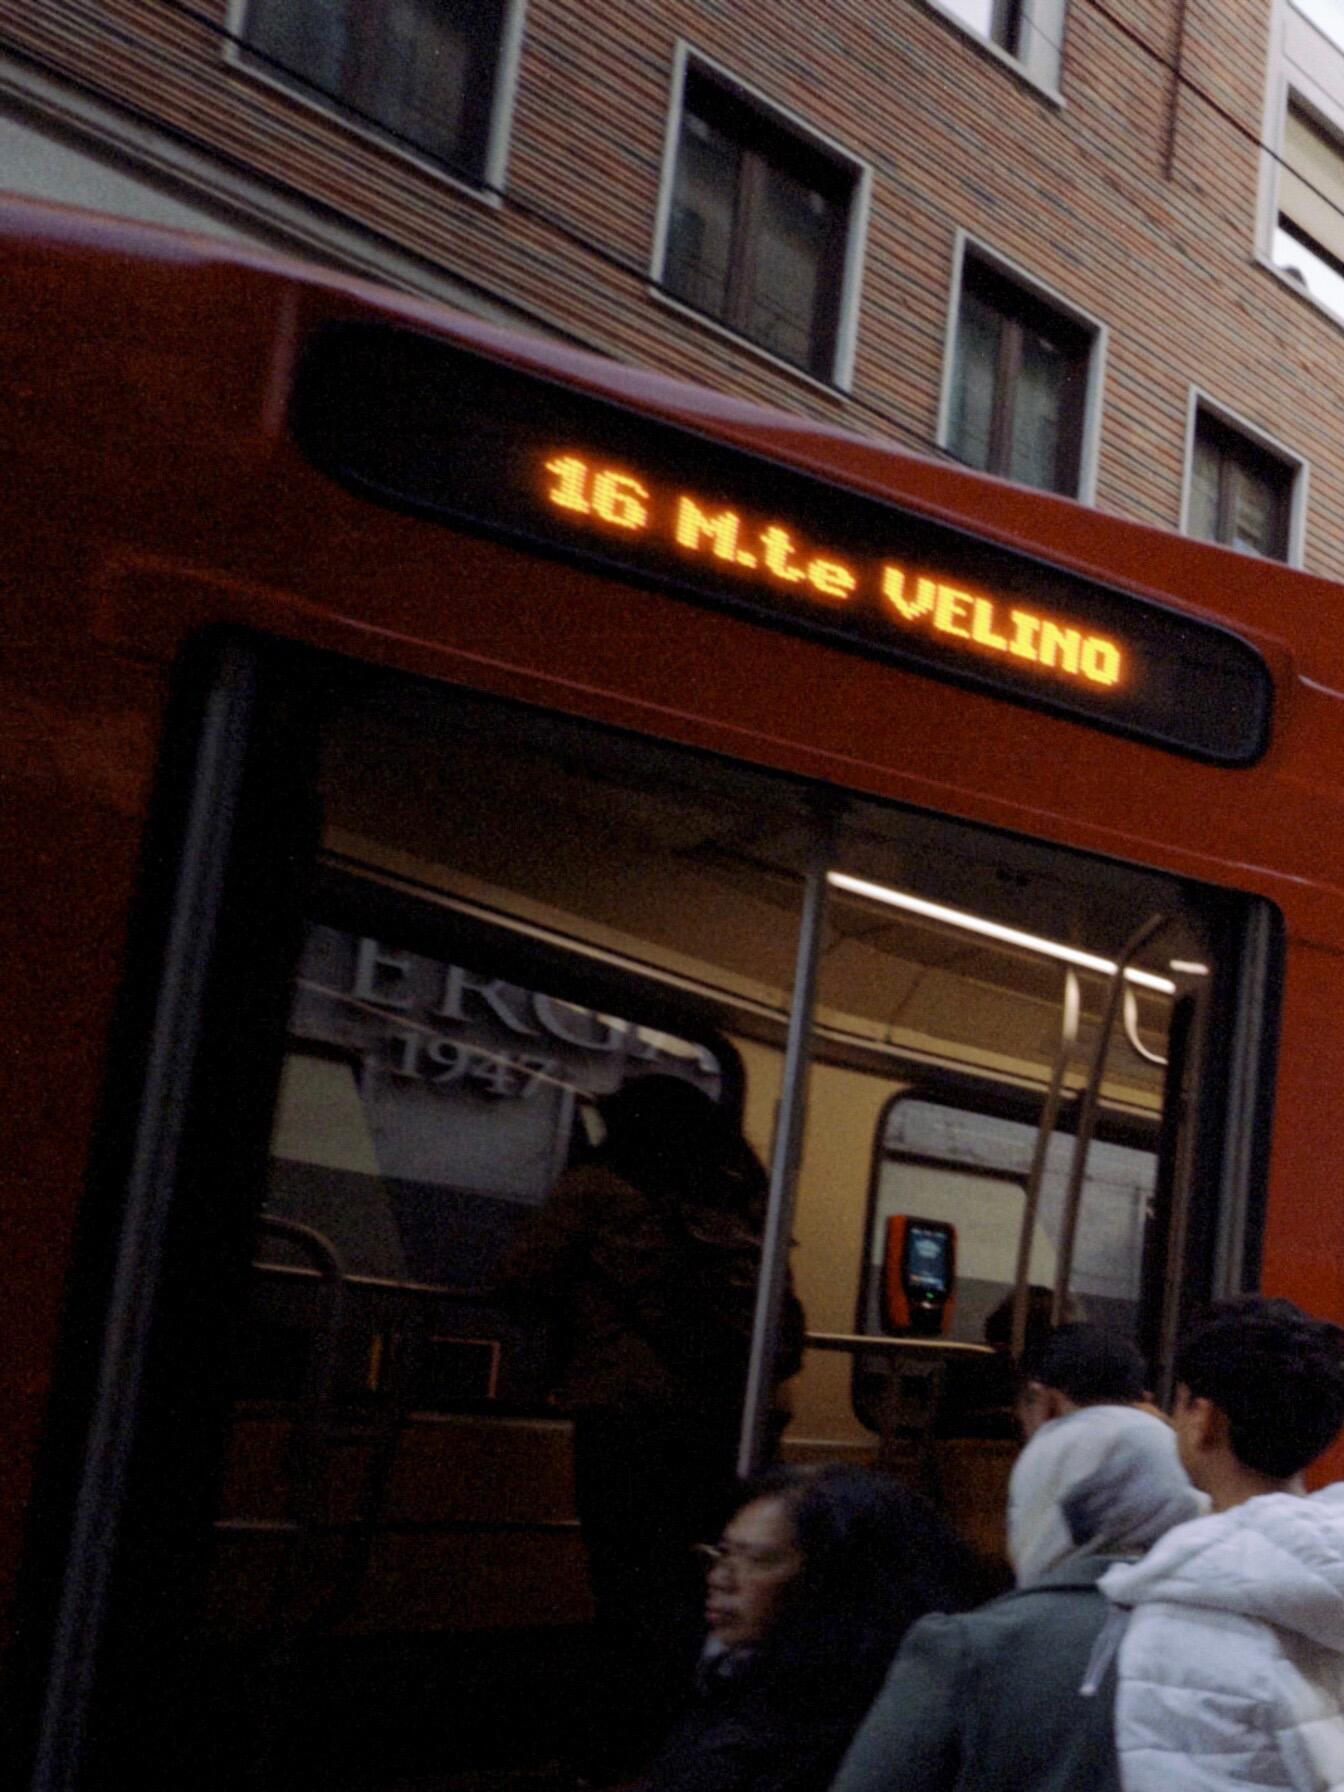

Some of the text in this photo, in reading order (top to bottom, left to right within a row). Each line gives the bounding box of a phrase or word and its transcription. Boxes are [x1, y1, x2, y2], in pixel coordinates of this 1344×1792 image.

[546, 453, 1122, 686] 16 M.te VELINO
